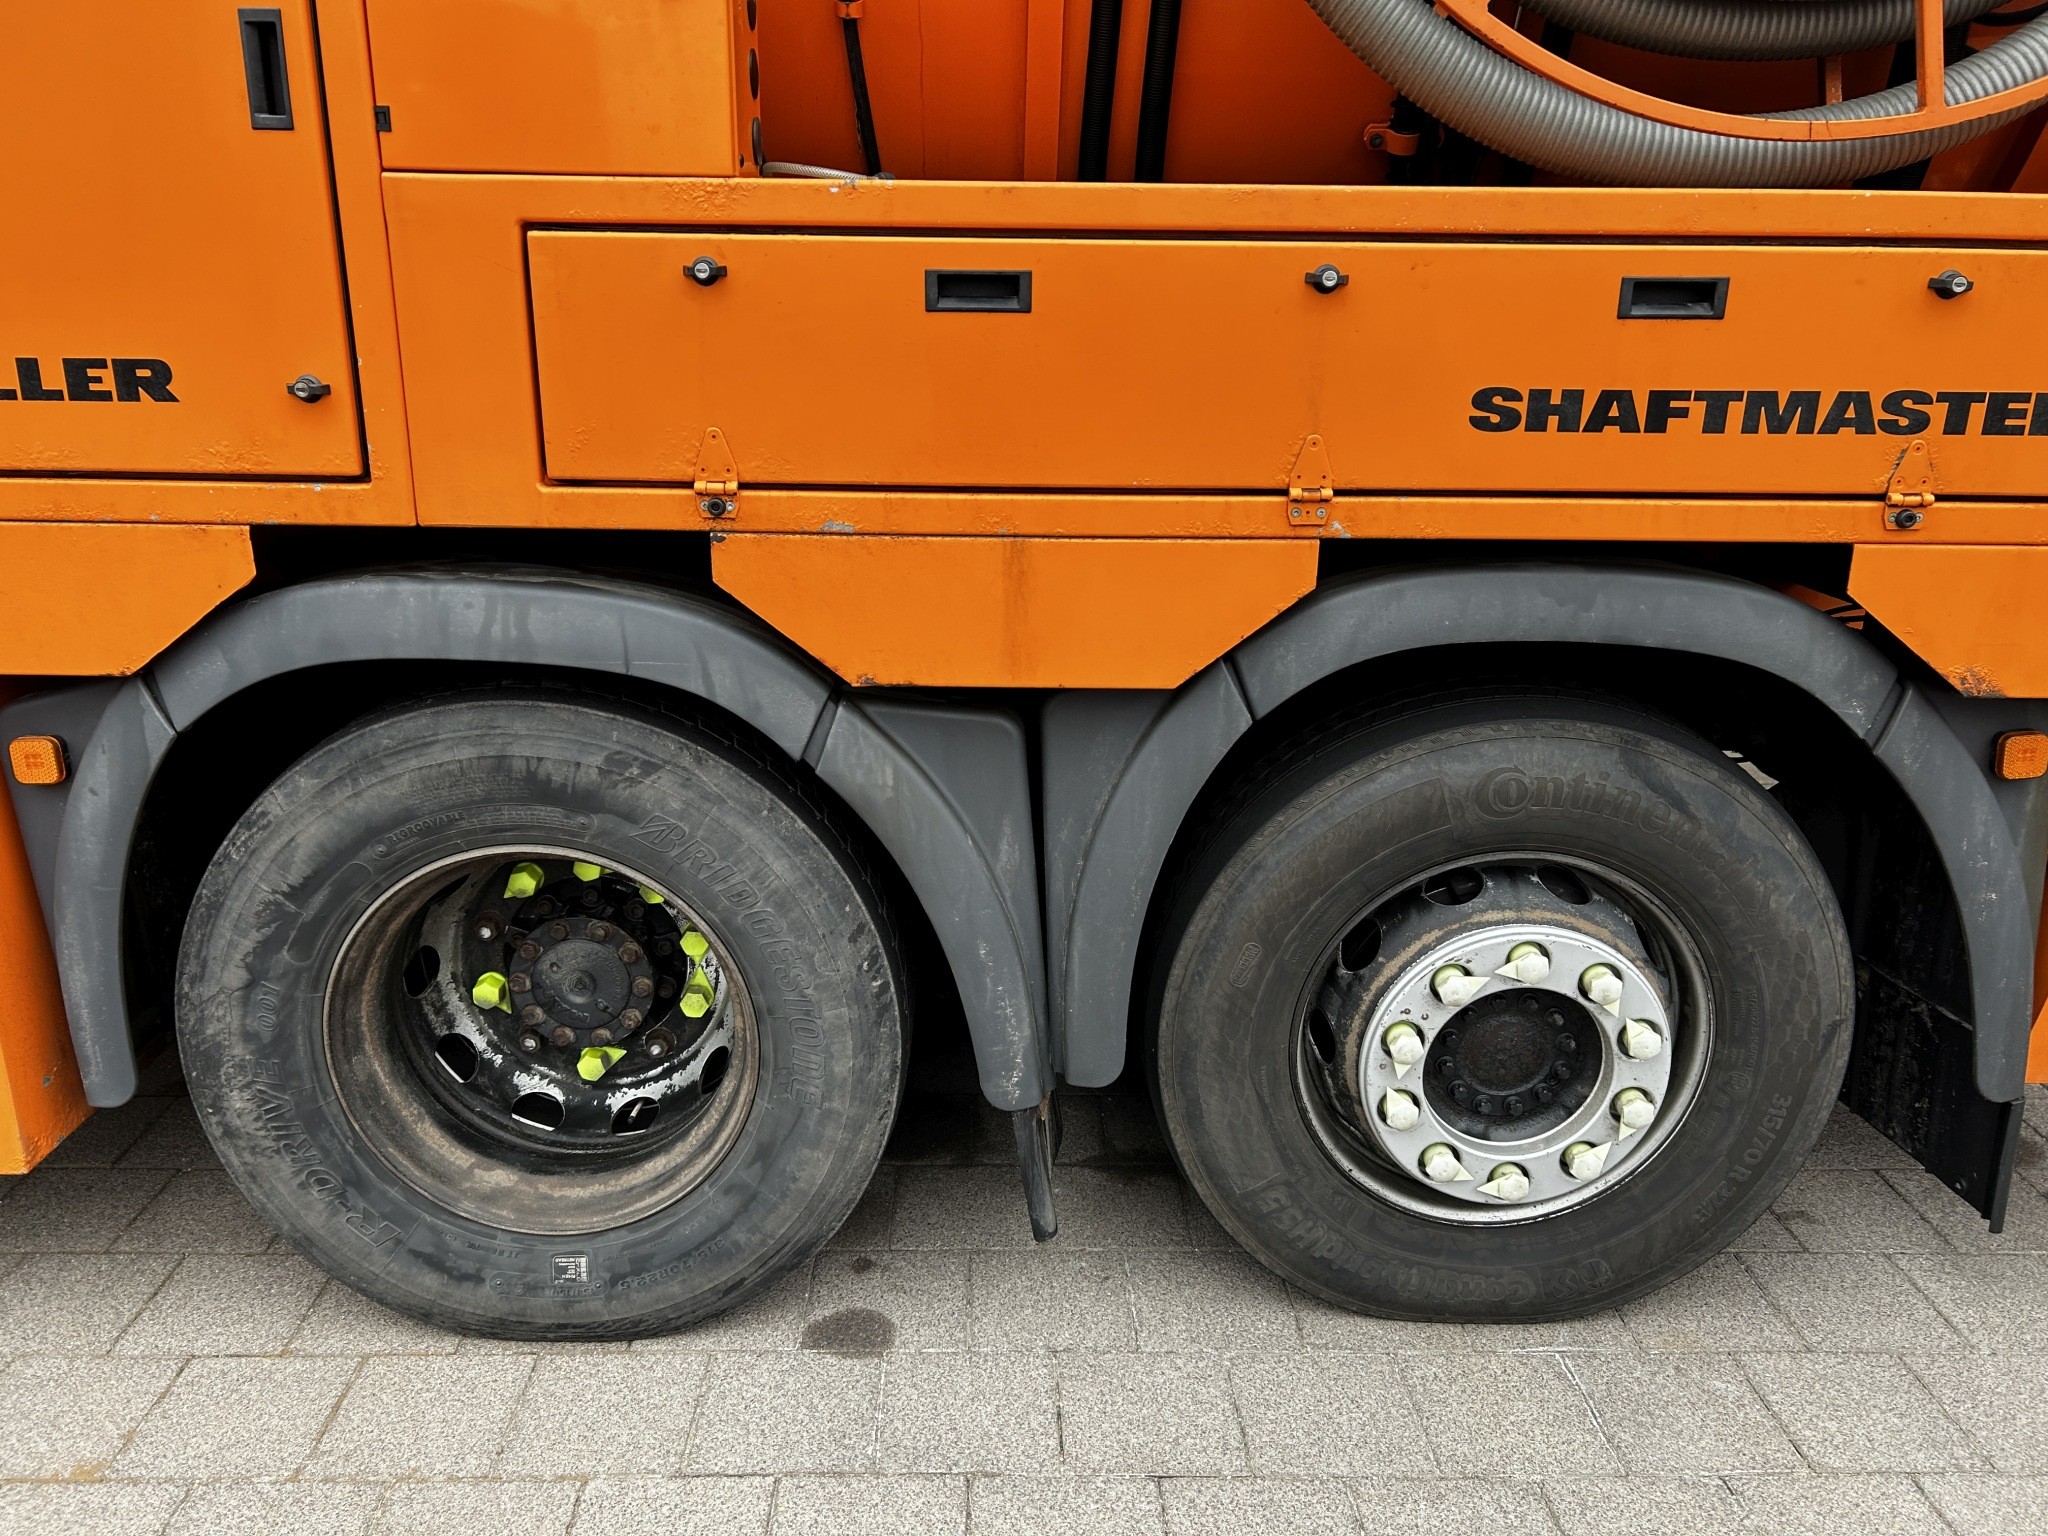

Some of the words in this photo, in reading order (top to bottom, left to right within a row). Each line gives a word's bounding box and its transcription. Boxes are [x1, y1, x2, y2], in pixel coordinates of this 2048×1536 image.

[629, 813, 826, 1103] BRIDGESTONE
[256, 980, 280, 1031] 001
[251, 1057, 402, 1246] R-DRIVE
[1737, 1091, 1793, 1167] 315/70
[1685, 1178, 1739, 1225] 22.5
[1725, 1162, 1752, 1186] R
